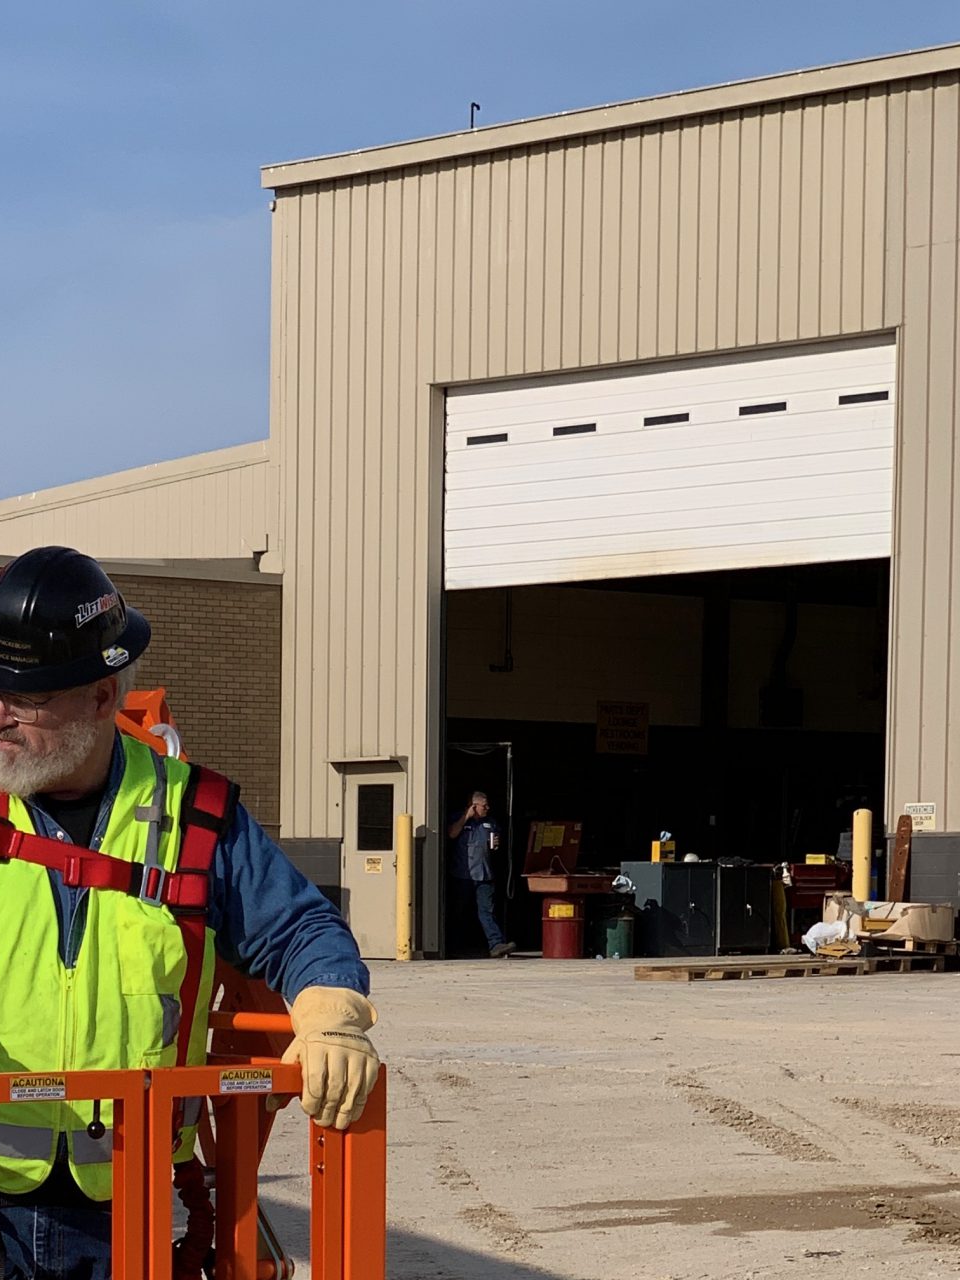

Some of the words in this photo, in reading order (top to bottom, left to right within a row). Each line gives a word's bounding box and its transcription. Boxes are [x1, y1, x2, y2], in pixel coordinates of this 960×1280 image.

[906, 806, 934, 814] NOTICE
[228, 1071, 266, 1080] CAUTION
[19, 1078, 58, 1086] CAUTION
